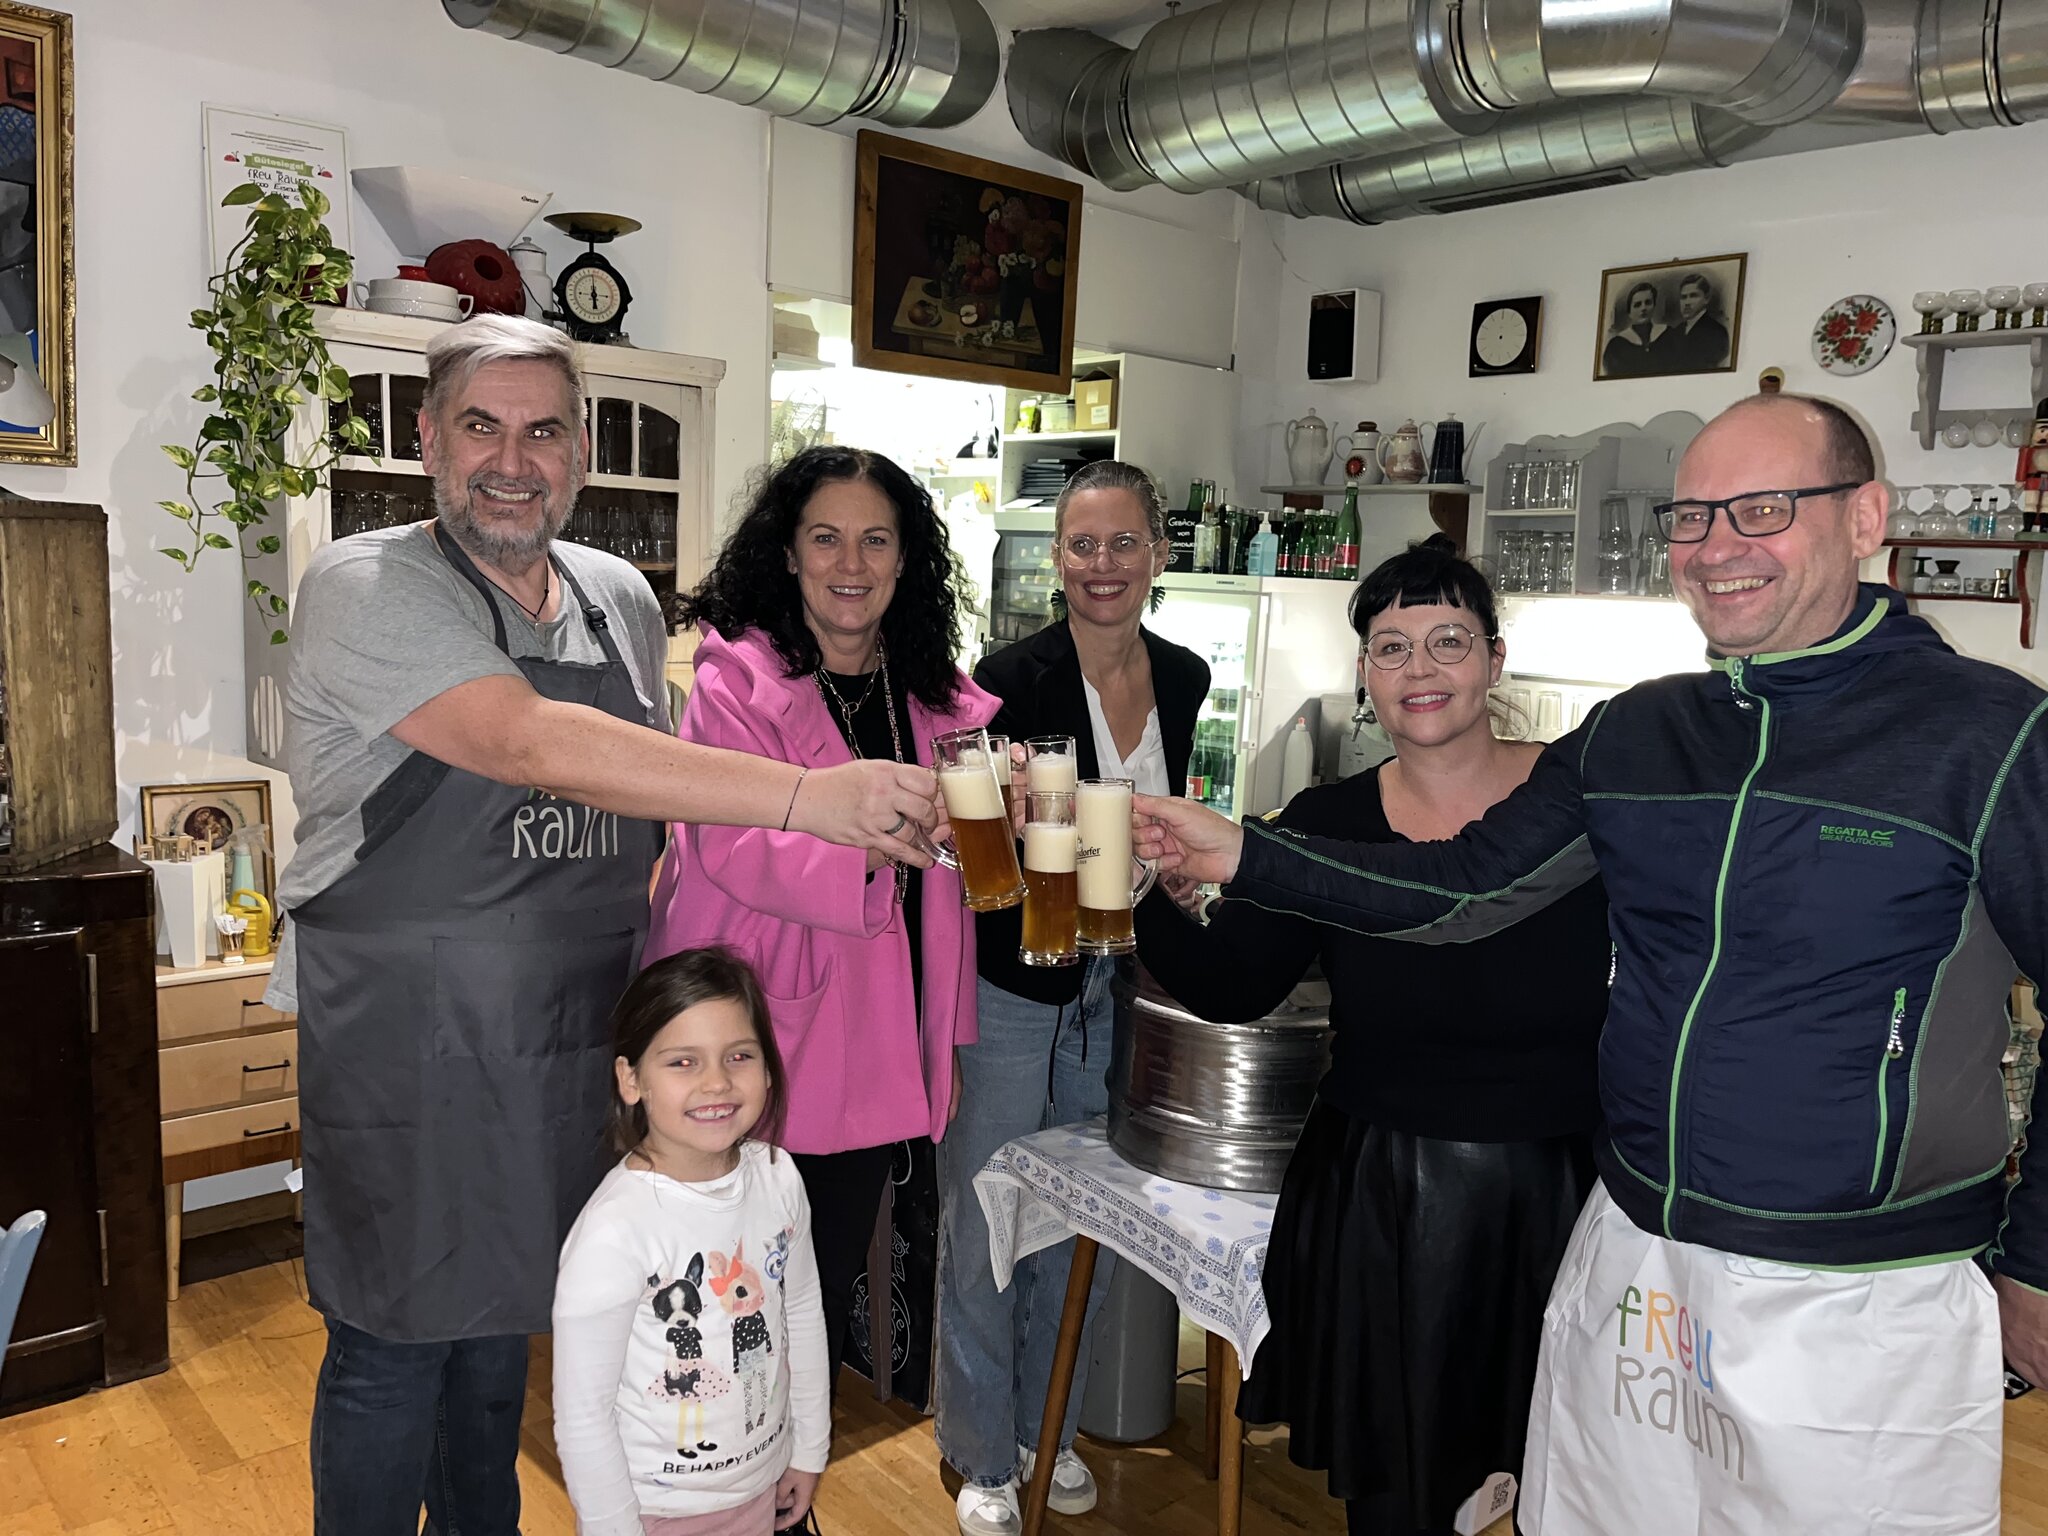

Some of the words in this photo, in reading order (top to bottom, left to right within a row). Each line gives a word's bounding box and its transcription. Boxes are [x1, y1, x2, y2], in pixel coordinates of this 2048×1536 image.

[1820, 825, 1869, 838] REGATTA
[1819, 833, 1845, 841] GREAT
[1844, 835, 1894, 848] OUTDOORS
[663, 1461, 686, 1474] BE
[690, 1454, 743, 1473] HAPPY
